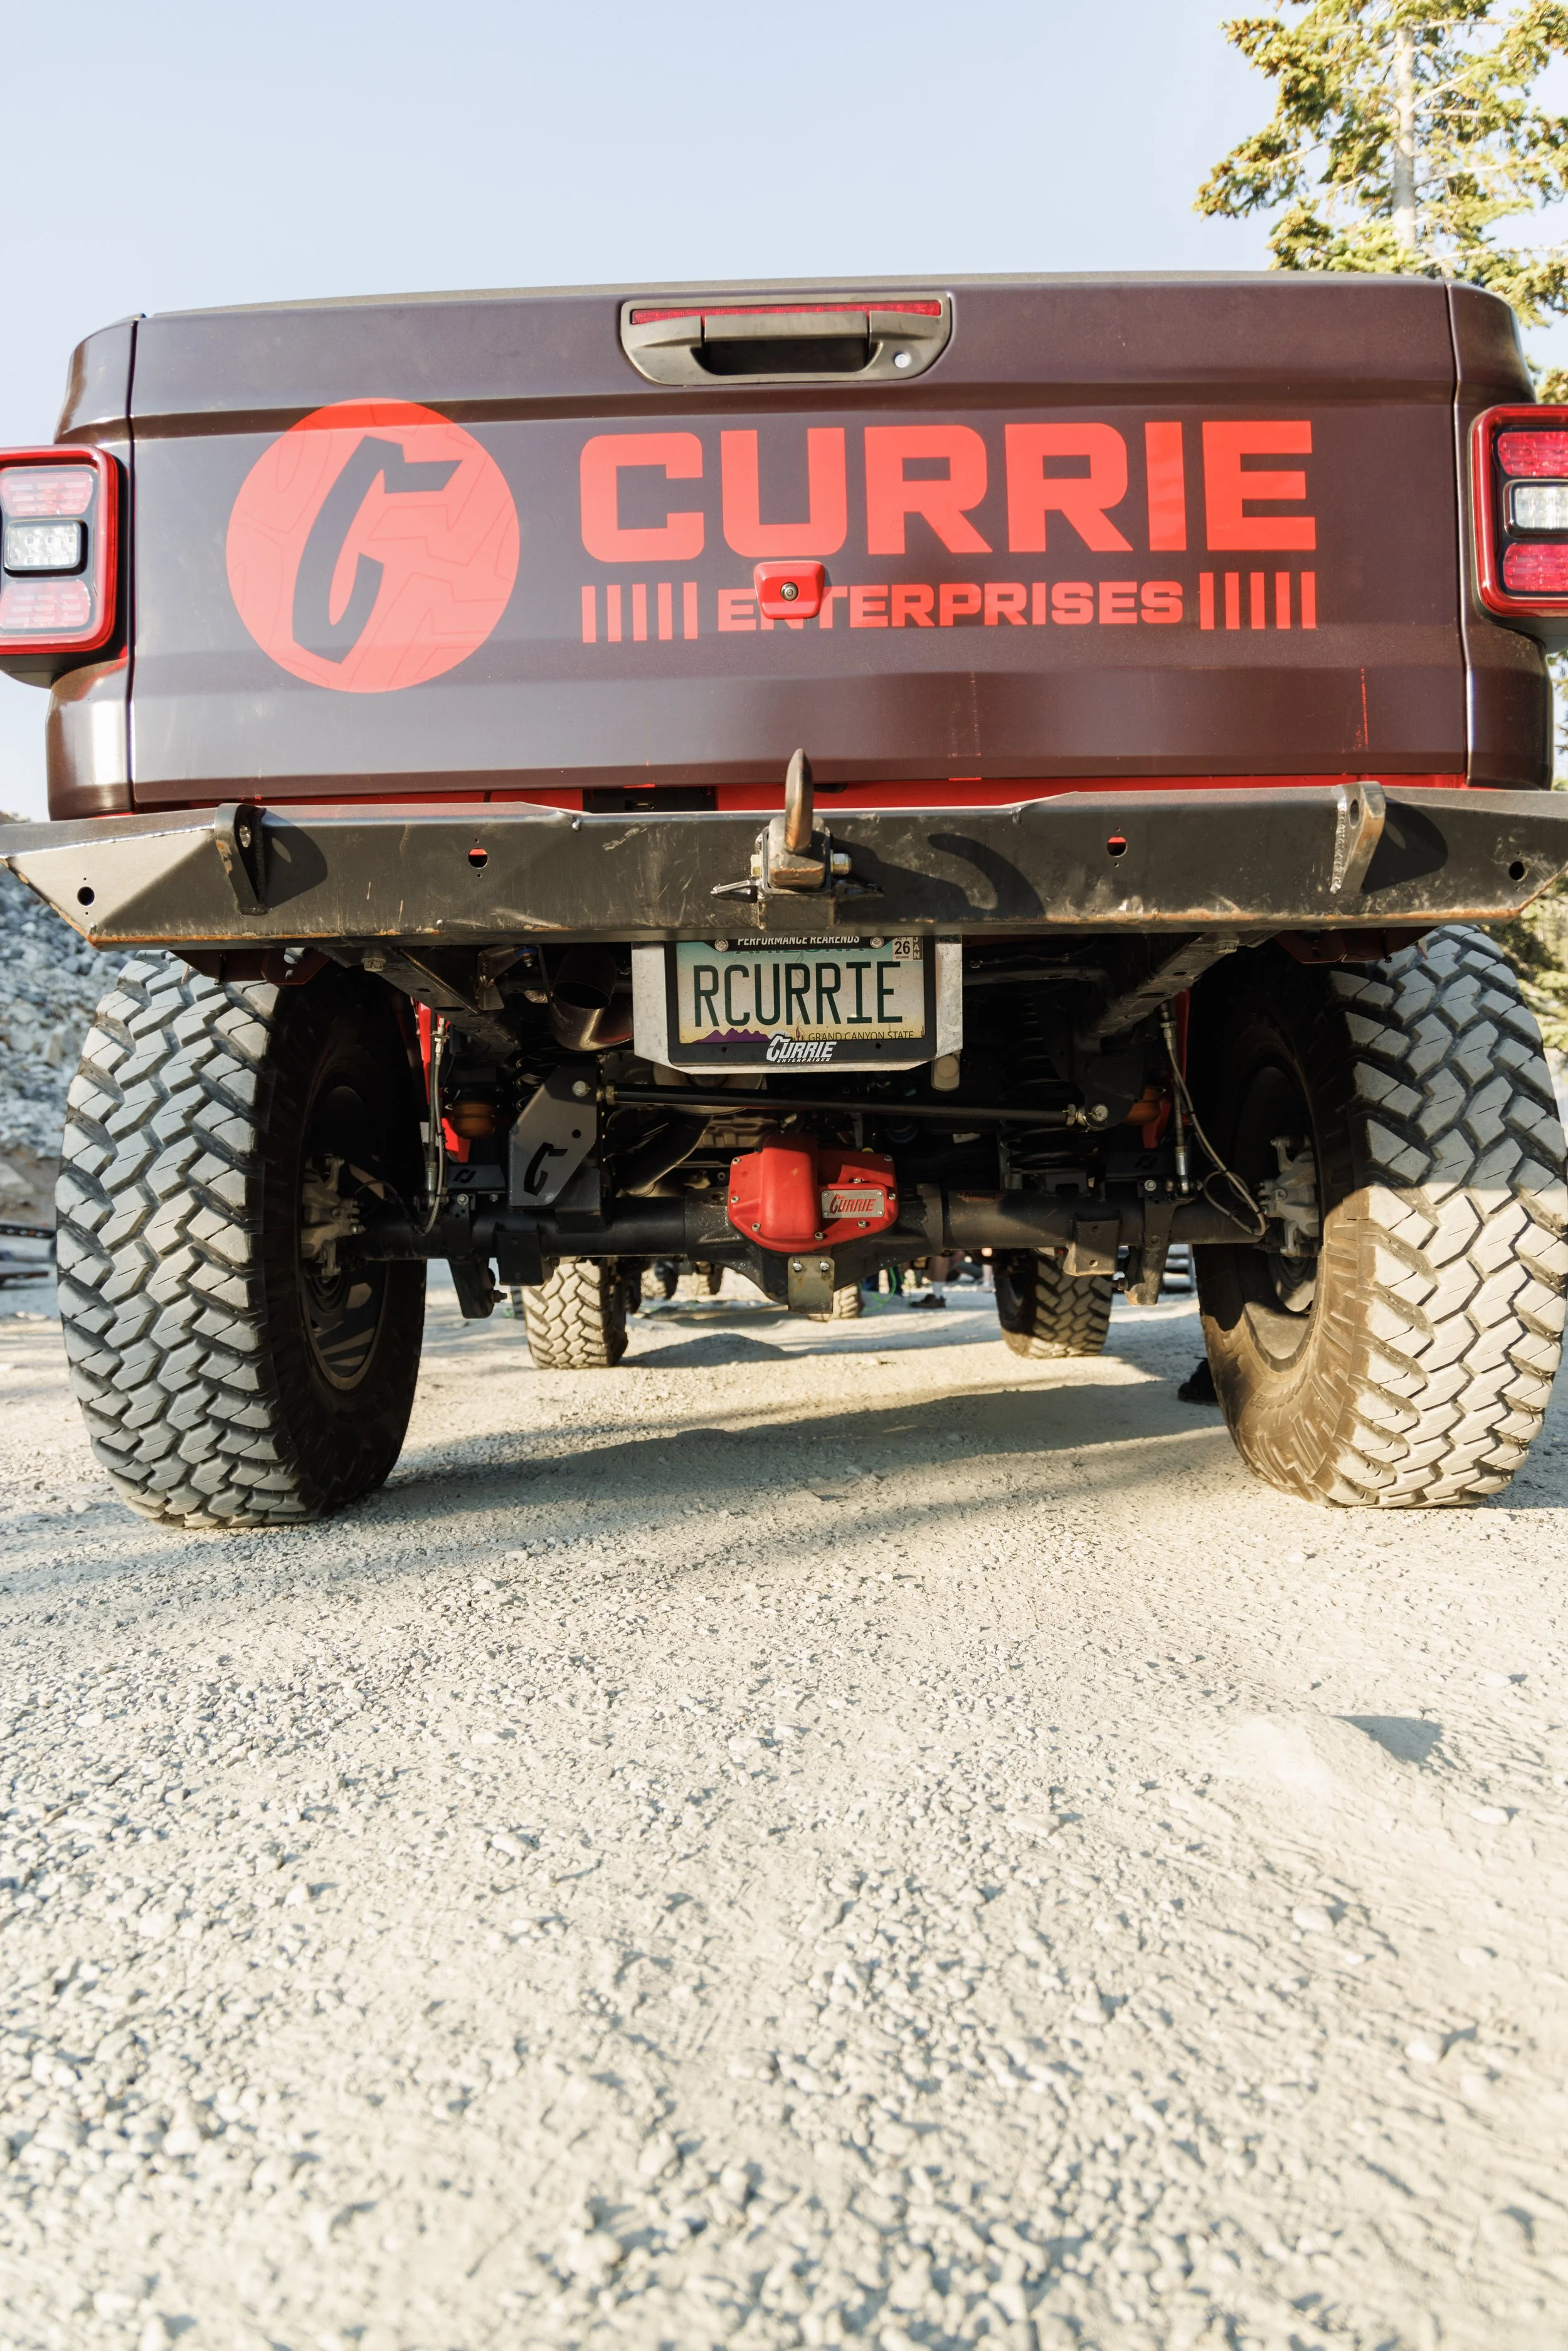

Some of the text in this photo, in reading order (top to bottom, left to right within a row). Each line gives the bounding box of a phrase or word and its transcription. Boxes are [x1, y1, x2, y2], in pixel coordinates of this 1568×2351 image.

[580, 421, 1316, 562] CURRIE
[718, 581, 1183, 631] ETERPRISES
[894, 941, 910, 954] 26
[693, 961, 903, 1027] RCURRIE
[766, 1034, 837, 1062] CURRIE
[808, 1031, 914, 1041] GRAND CANYON STATE
[829, 1194, 876, 1215] CURRIE
